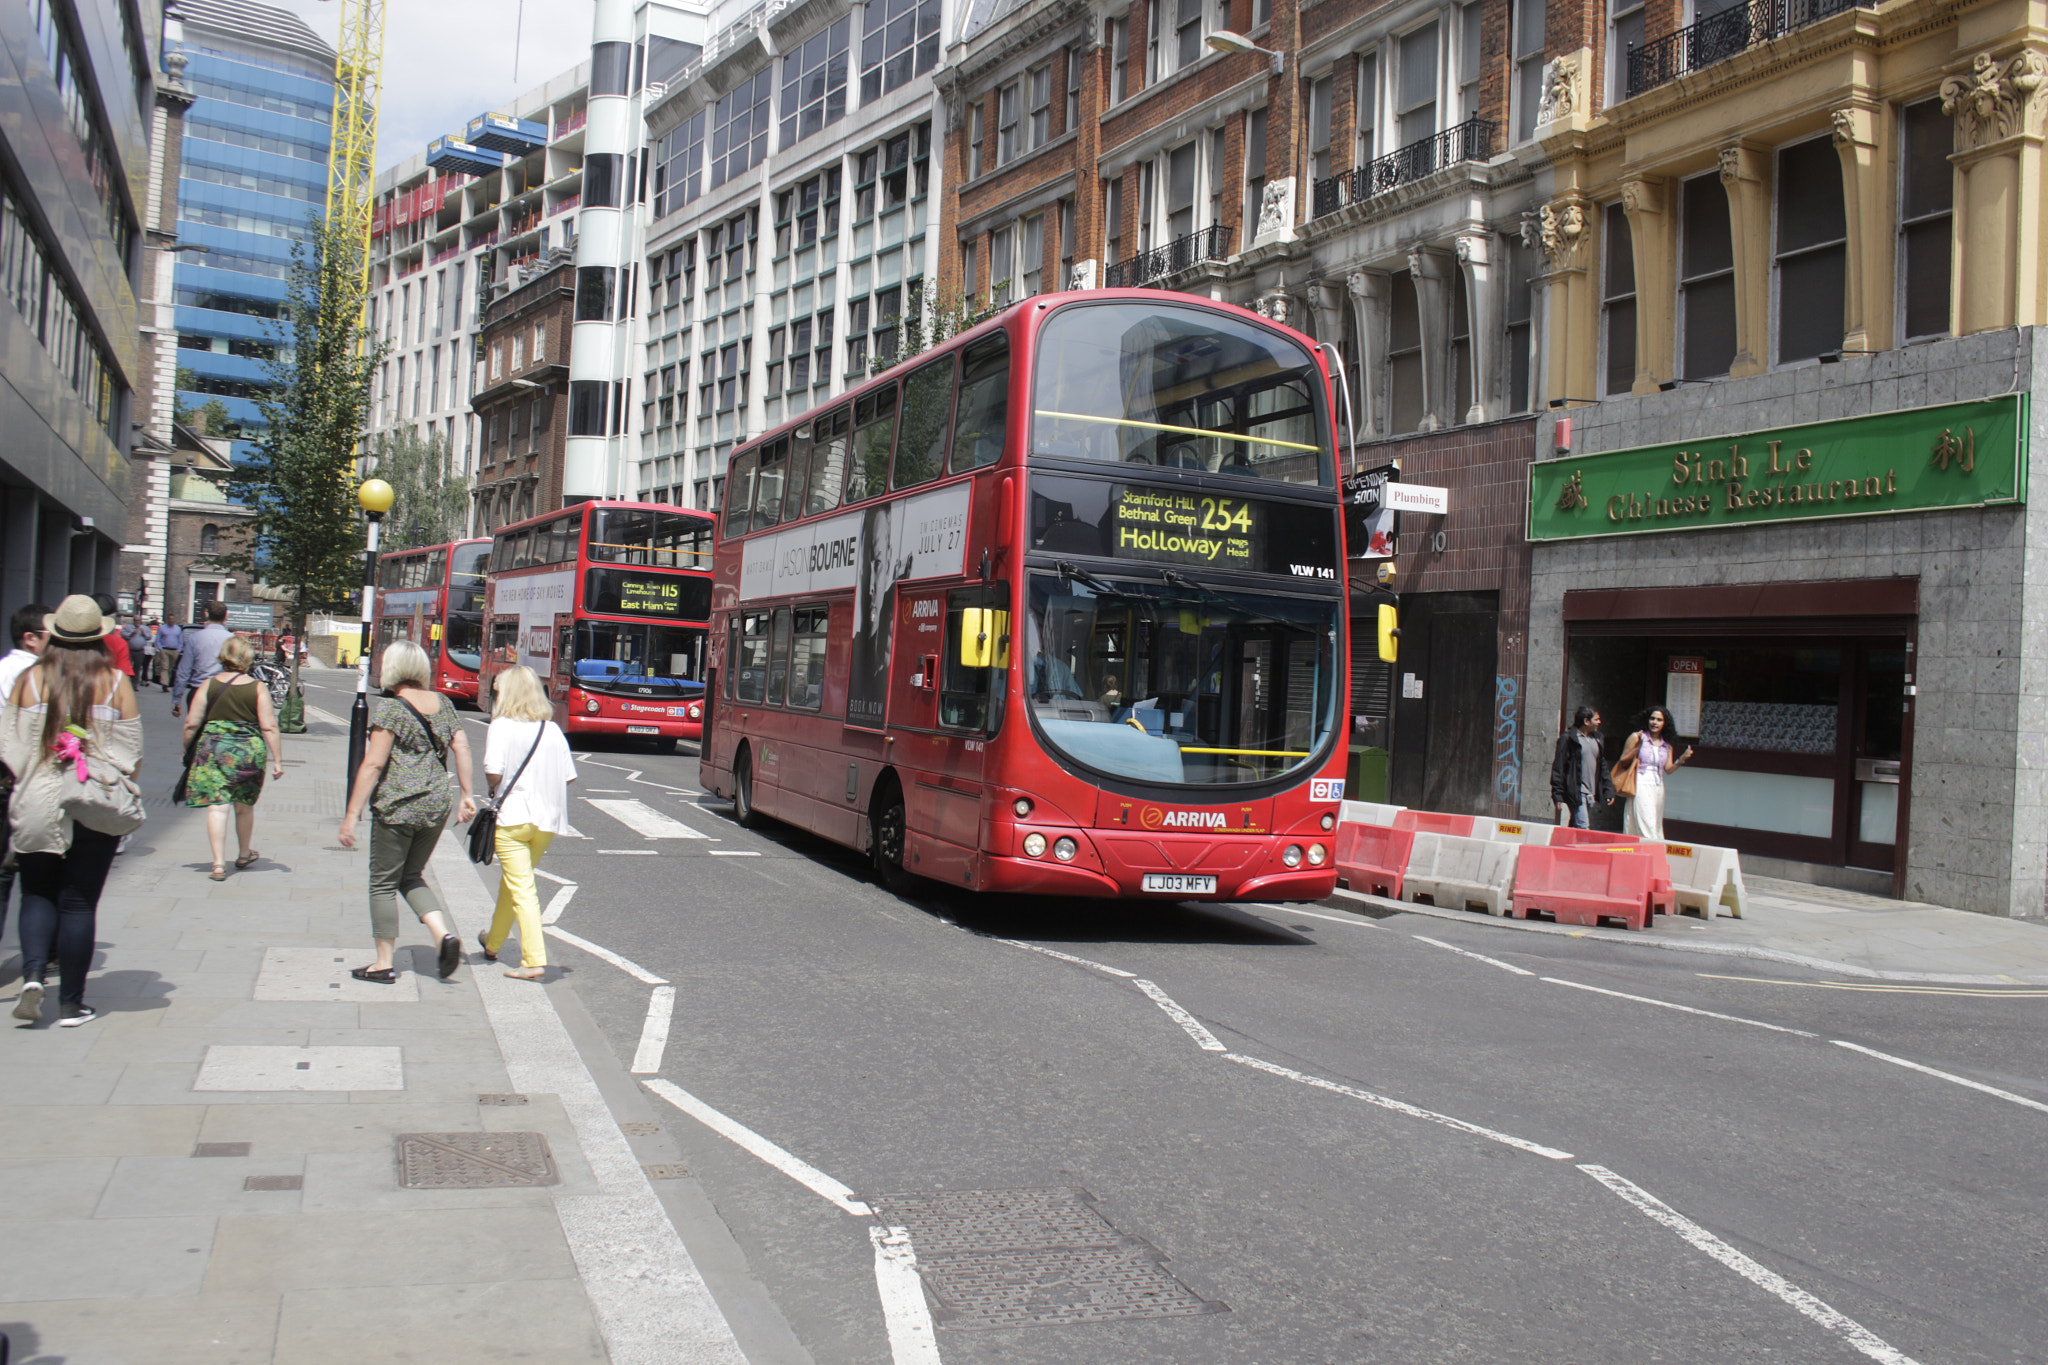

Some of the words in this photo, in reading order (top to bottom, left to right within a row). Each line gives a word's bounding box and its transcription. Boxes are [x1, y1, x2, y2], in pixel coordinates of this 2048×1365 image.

[1928, 425, 1975, 472] 利
[1672, 444, 1749, 485] Sinh
[1765, 439, 1813, 475] Le
[1346, 471, 1389, 490] OPENING
[1122, 490, 1173, 508] Stamford
[1175, 496, 1196, 511] Hill
[1353, 488, 1380, 505] SOON
[1393, 490, 1441, 508] Plumbing
[1607, 492, 1711, 520] Chinese
[1723, 468, 1898, 510] Restaurant
[1118, 504, 1161, 522] Bethnal
[1164, 510, 1198, 526] Green
[1200, 497, 1253, 534] 254
[918, 533, 943, 555] JULY
[947, 530, 961, 550] 27
[1120, 526, 1223, 560] Holloway
[1227, 537, 1249, 549] Nags
[1430, 531, 1447, 553] 10
[808, 536, 857, 573] BOURNE
[1226, 547, 1250, 558] Head
[1289, 563, 1315, 577] VLW
[1316, 567, 1335, 580] 141
[661, 584, 679, 598] 115
[621, 599, 640, 609] East
[642, 600, 664, 610] Ham
[911, 599, 939, 618] ARRIVA
[1673, 660, 1698, 671] OPEN
[630, 704, 666, 713] Stagecoach
[1162, 811, 1227, 828] ARRIVA
[1498, 825, 1522, 834] RINEY
[1666, 846, 1692, 856] RINEY
[1148, 875, 1183, 890] LJ03
[1186, 876, 1212, 891] MFV
